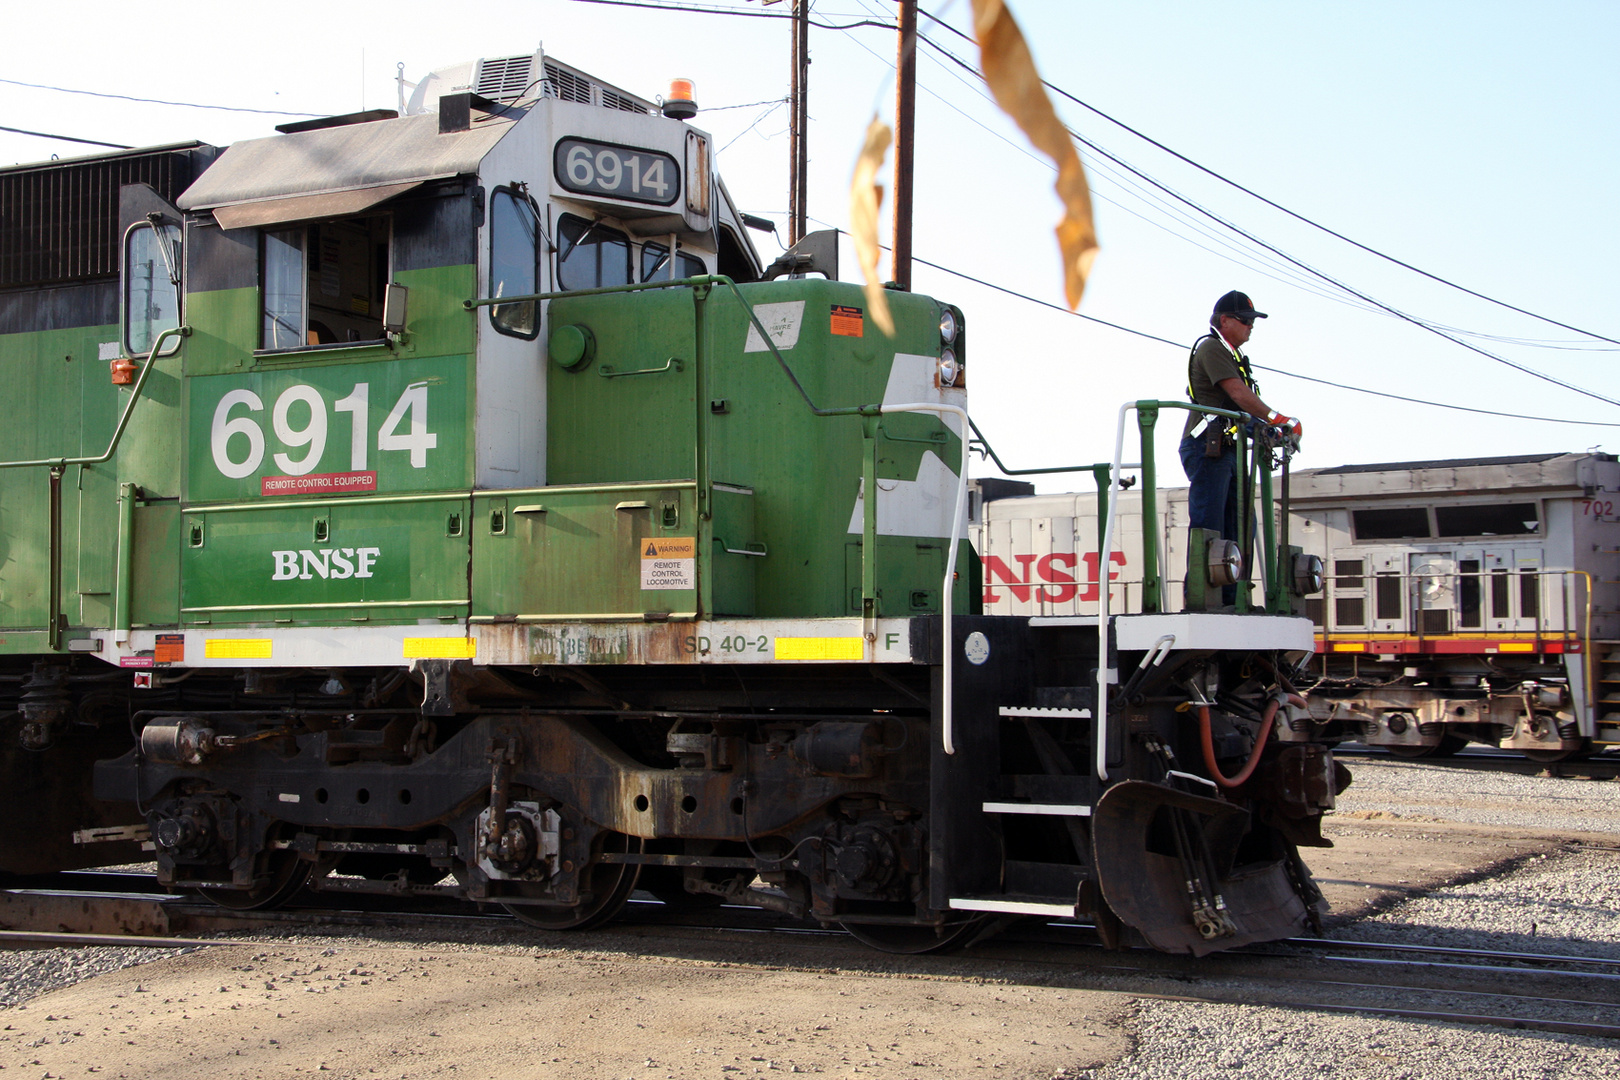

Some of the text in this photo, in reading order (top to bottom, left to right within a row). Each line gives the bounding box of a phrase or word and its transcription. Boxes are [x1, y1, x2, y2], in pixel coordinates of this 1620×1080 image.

[566, 145, 669, 197] 6914
[211, 381, 437, 479] 6914
[265, 475, 373, 490] REMOTE CONTROL EQUIPPED
[1582, 500, 1613, 516] 702
[658, 545, 692, 553] WARNING!
[271, 547, 381, 581] BNSF
[653, 561, 681, 569] REMOTE
[646, 578, 689, 586] LOCOMOTIVE
[979, 551, 1127, 603] NSF
[684, 635, 768, 653] SD 40-2
[885, 632, 901, 650] F
